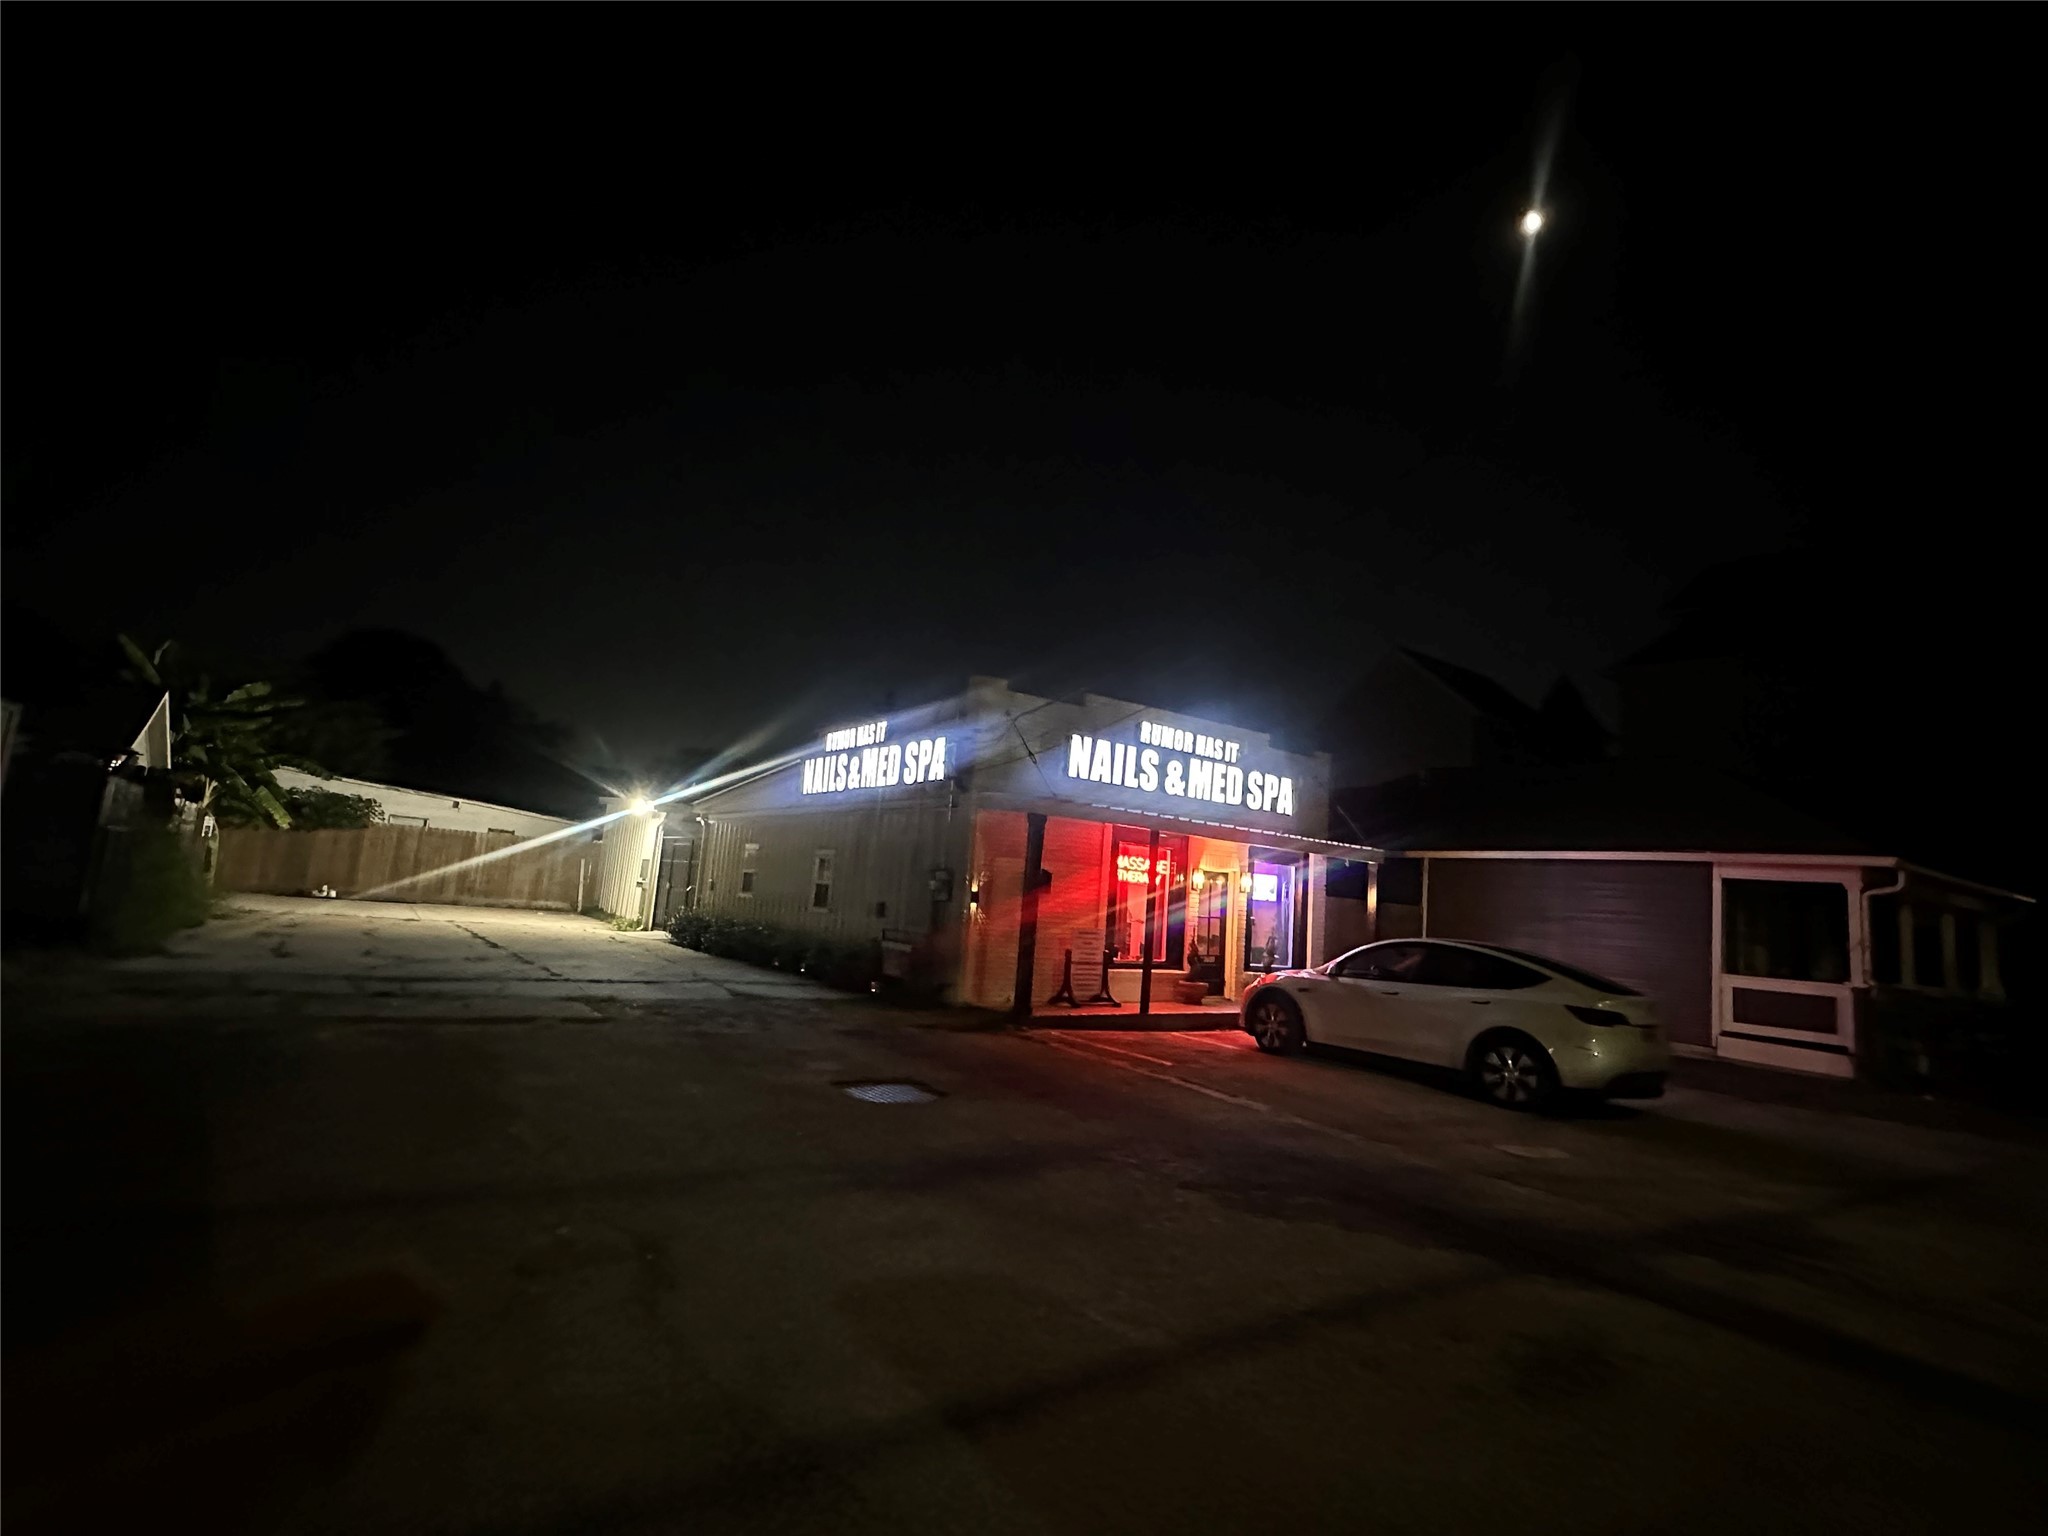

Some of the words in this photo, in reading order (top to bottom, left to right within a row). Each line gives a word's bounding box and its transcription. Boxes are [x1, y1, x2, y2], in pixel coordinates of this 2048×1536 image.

[875, 721, 888, 744] IT
[1140, 720, 1195, 753] RUMOR
[1195, 734, 1223, 760] HAS
[1224, 741, 1240, 763] IT
[803, 753, 848, 795] NAILS
[848, 756, 860, 790] &
[861, 744, 901, 788] MED
[903, 737, 946, 785] SPA
[1068, 733, 1159, 792] NAILS
[1164, 760, 1185, 797] &
[1188, 758, 1243, 805] MED
[1246, 770, 1294, 816] SPA
